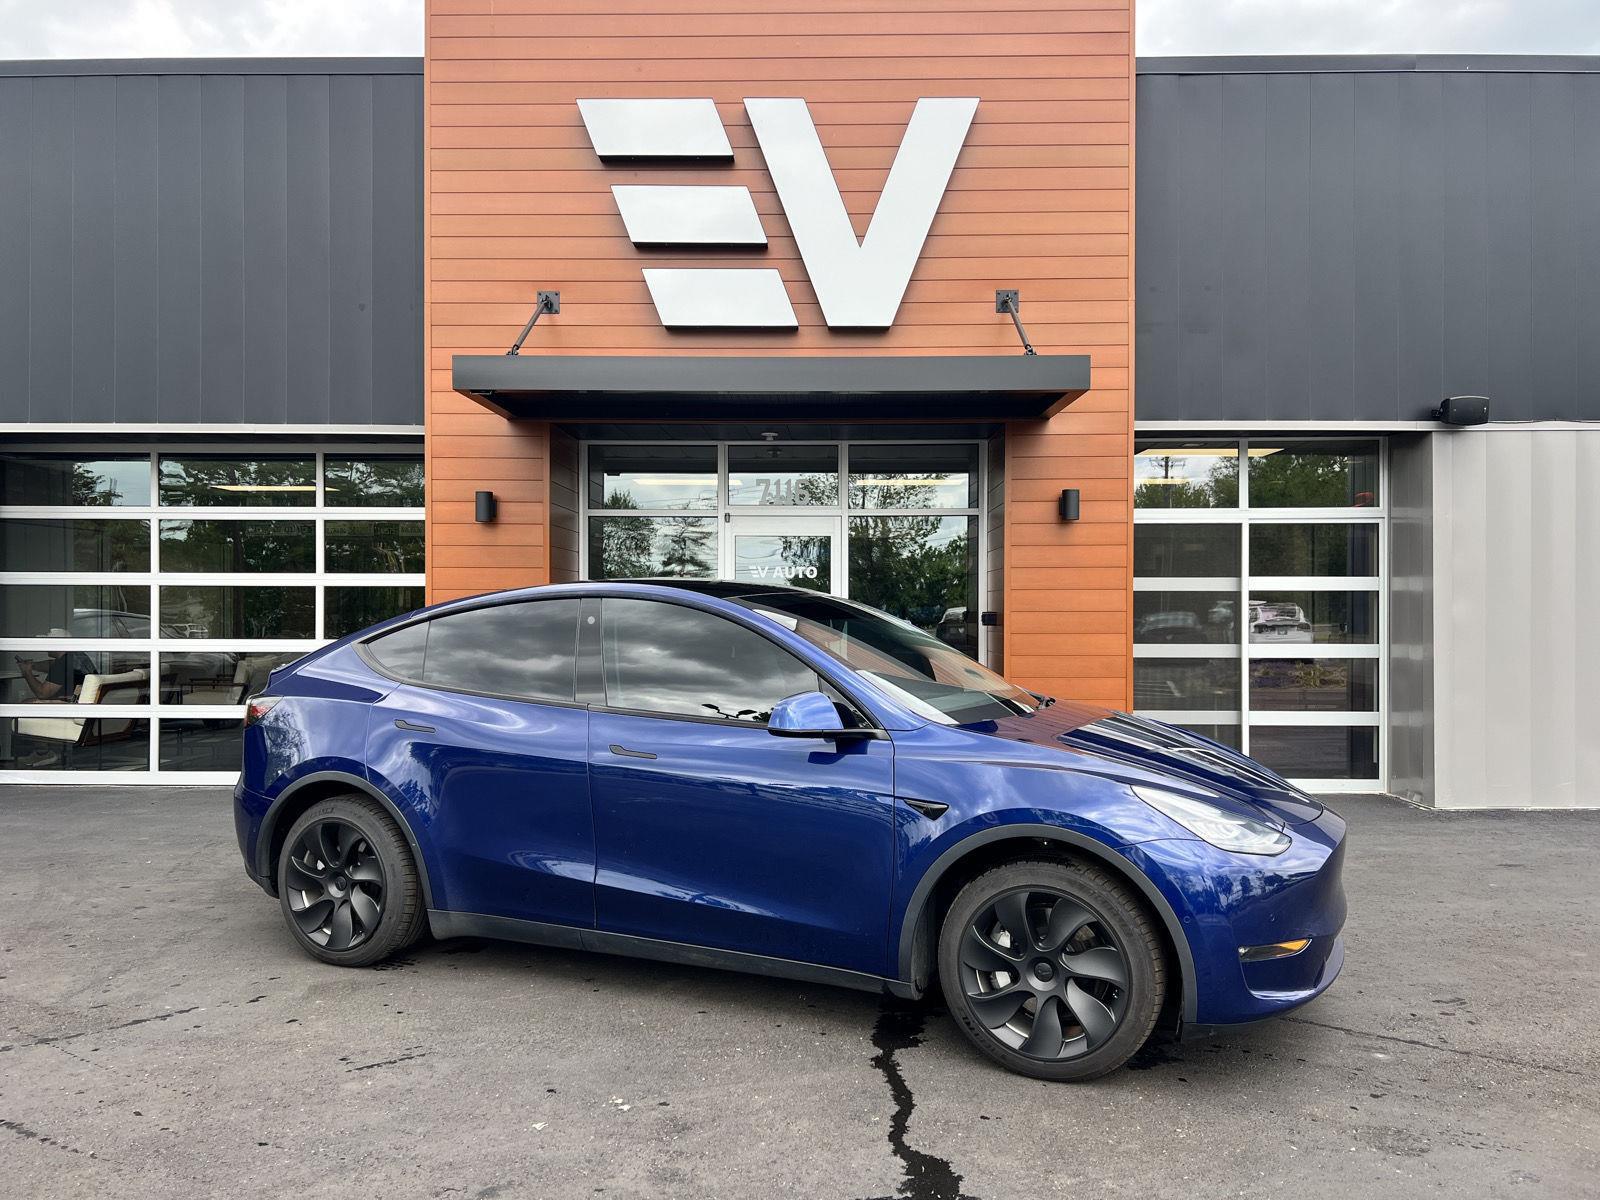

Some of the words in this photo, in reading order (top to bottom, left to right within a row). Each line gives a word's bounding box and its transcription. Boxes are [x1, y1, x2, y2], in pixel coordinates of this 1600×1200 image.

[575, 96, 981, 329] EV
[749, 565, 769, 578] EV
[772, 566, 818, 579] AUTO
